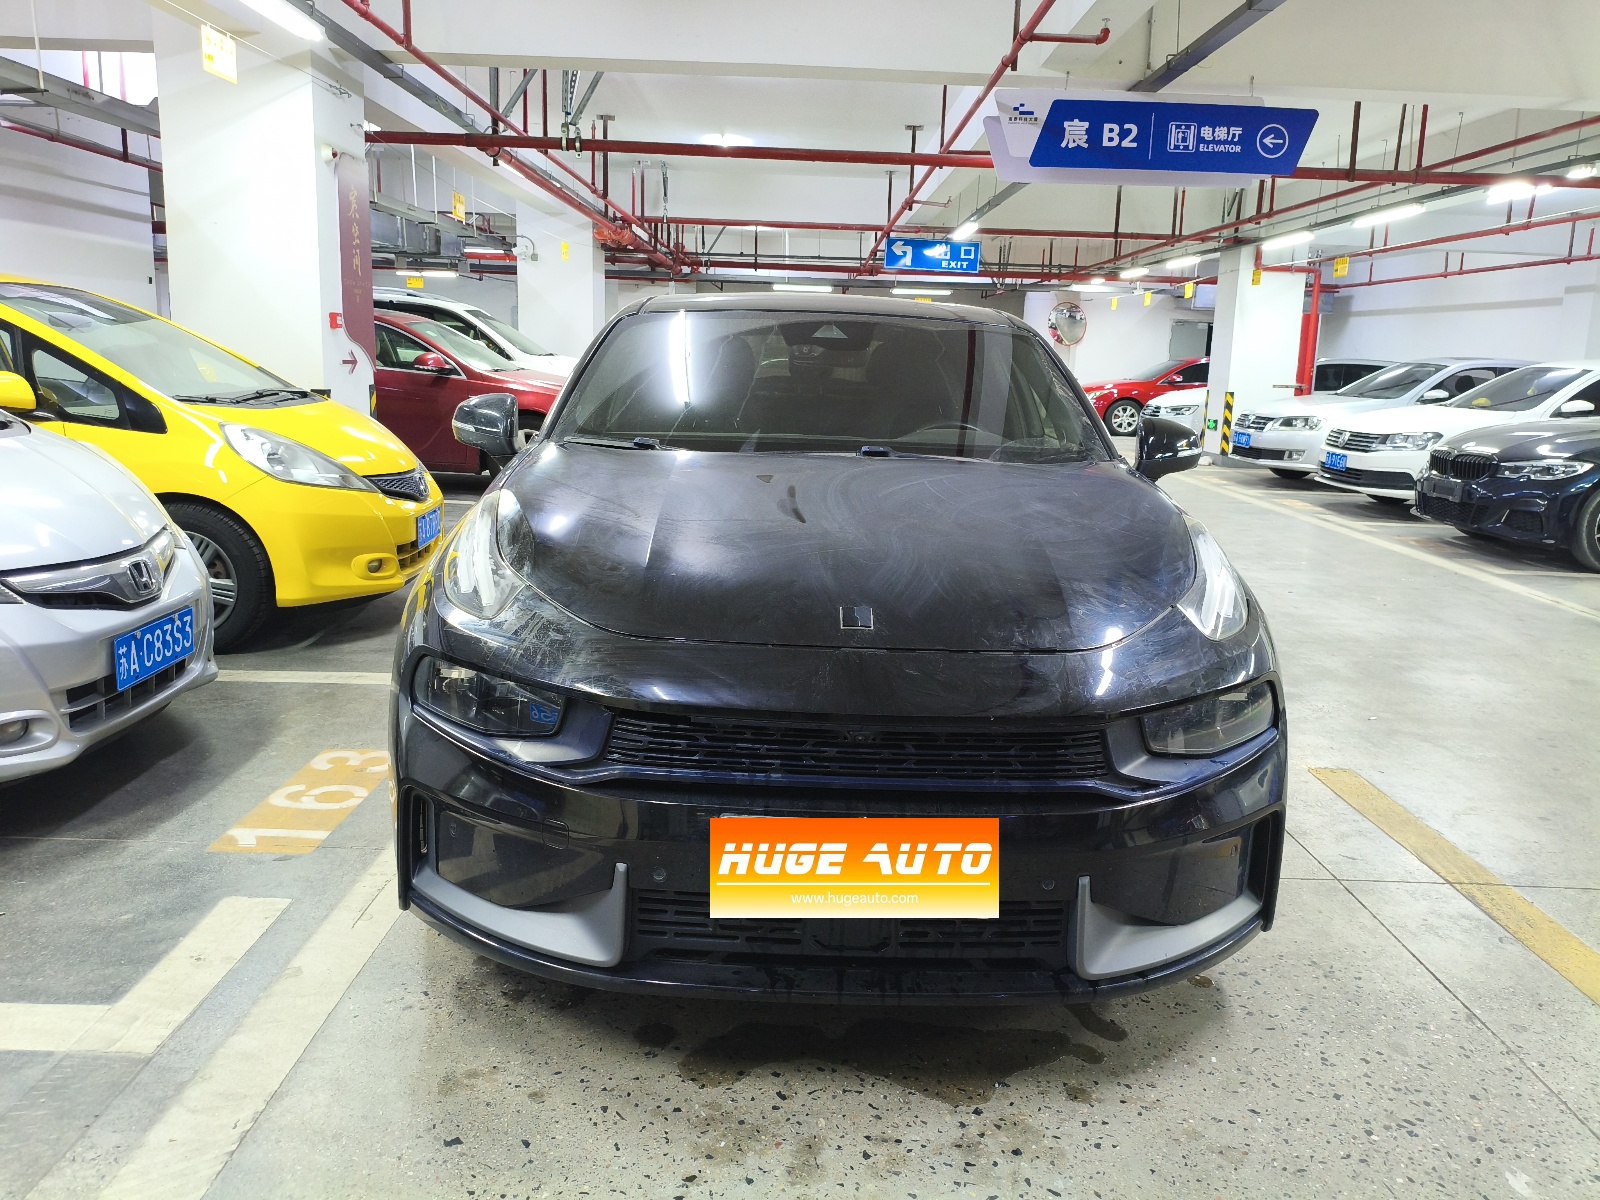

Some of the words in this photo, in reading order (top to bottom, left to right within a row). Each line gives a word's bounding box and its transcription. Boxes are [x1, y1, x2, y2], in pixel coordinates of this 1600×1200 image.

[1060, 118, 1089, 148] 宸
[1102, 123, 1138, 147] B2
[1200, 125, 1243, 142] 电梯厅
[1199, 143, 1242, 152] ELEVATOR
[941, 260, 969, 269] EXIT
[226, 750, 390, 847] 163
